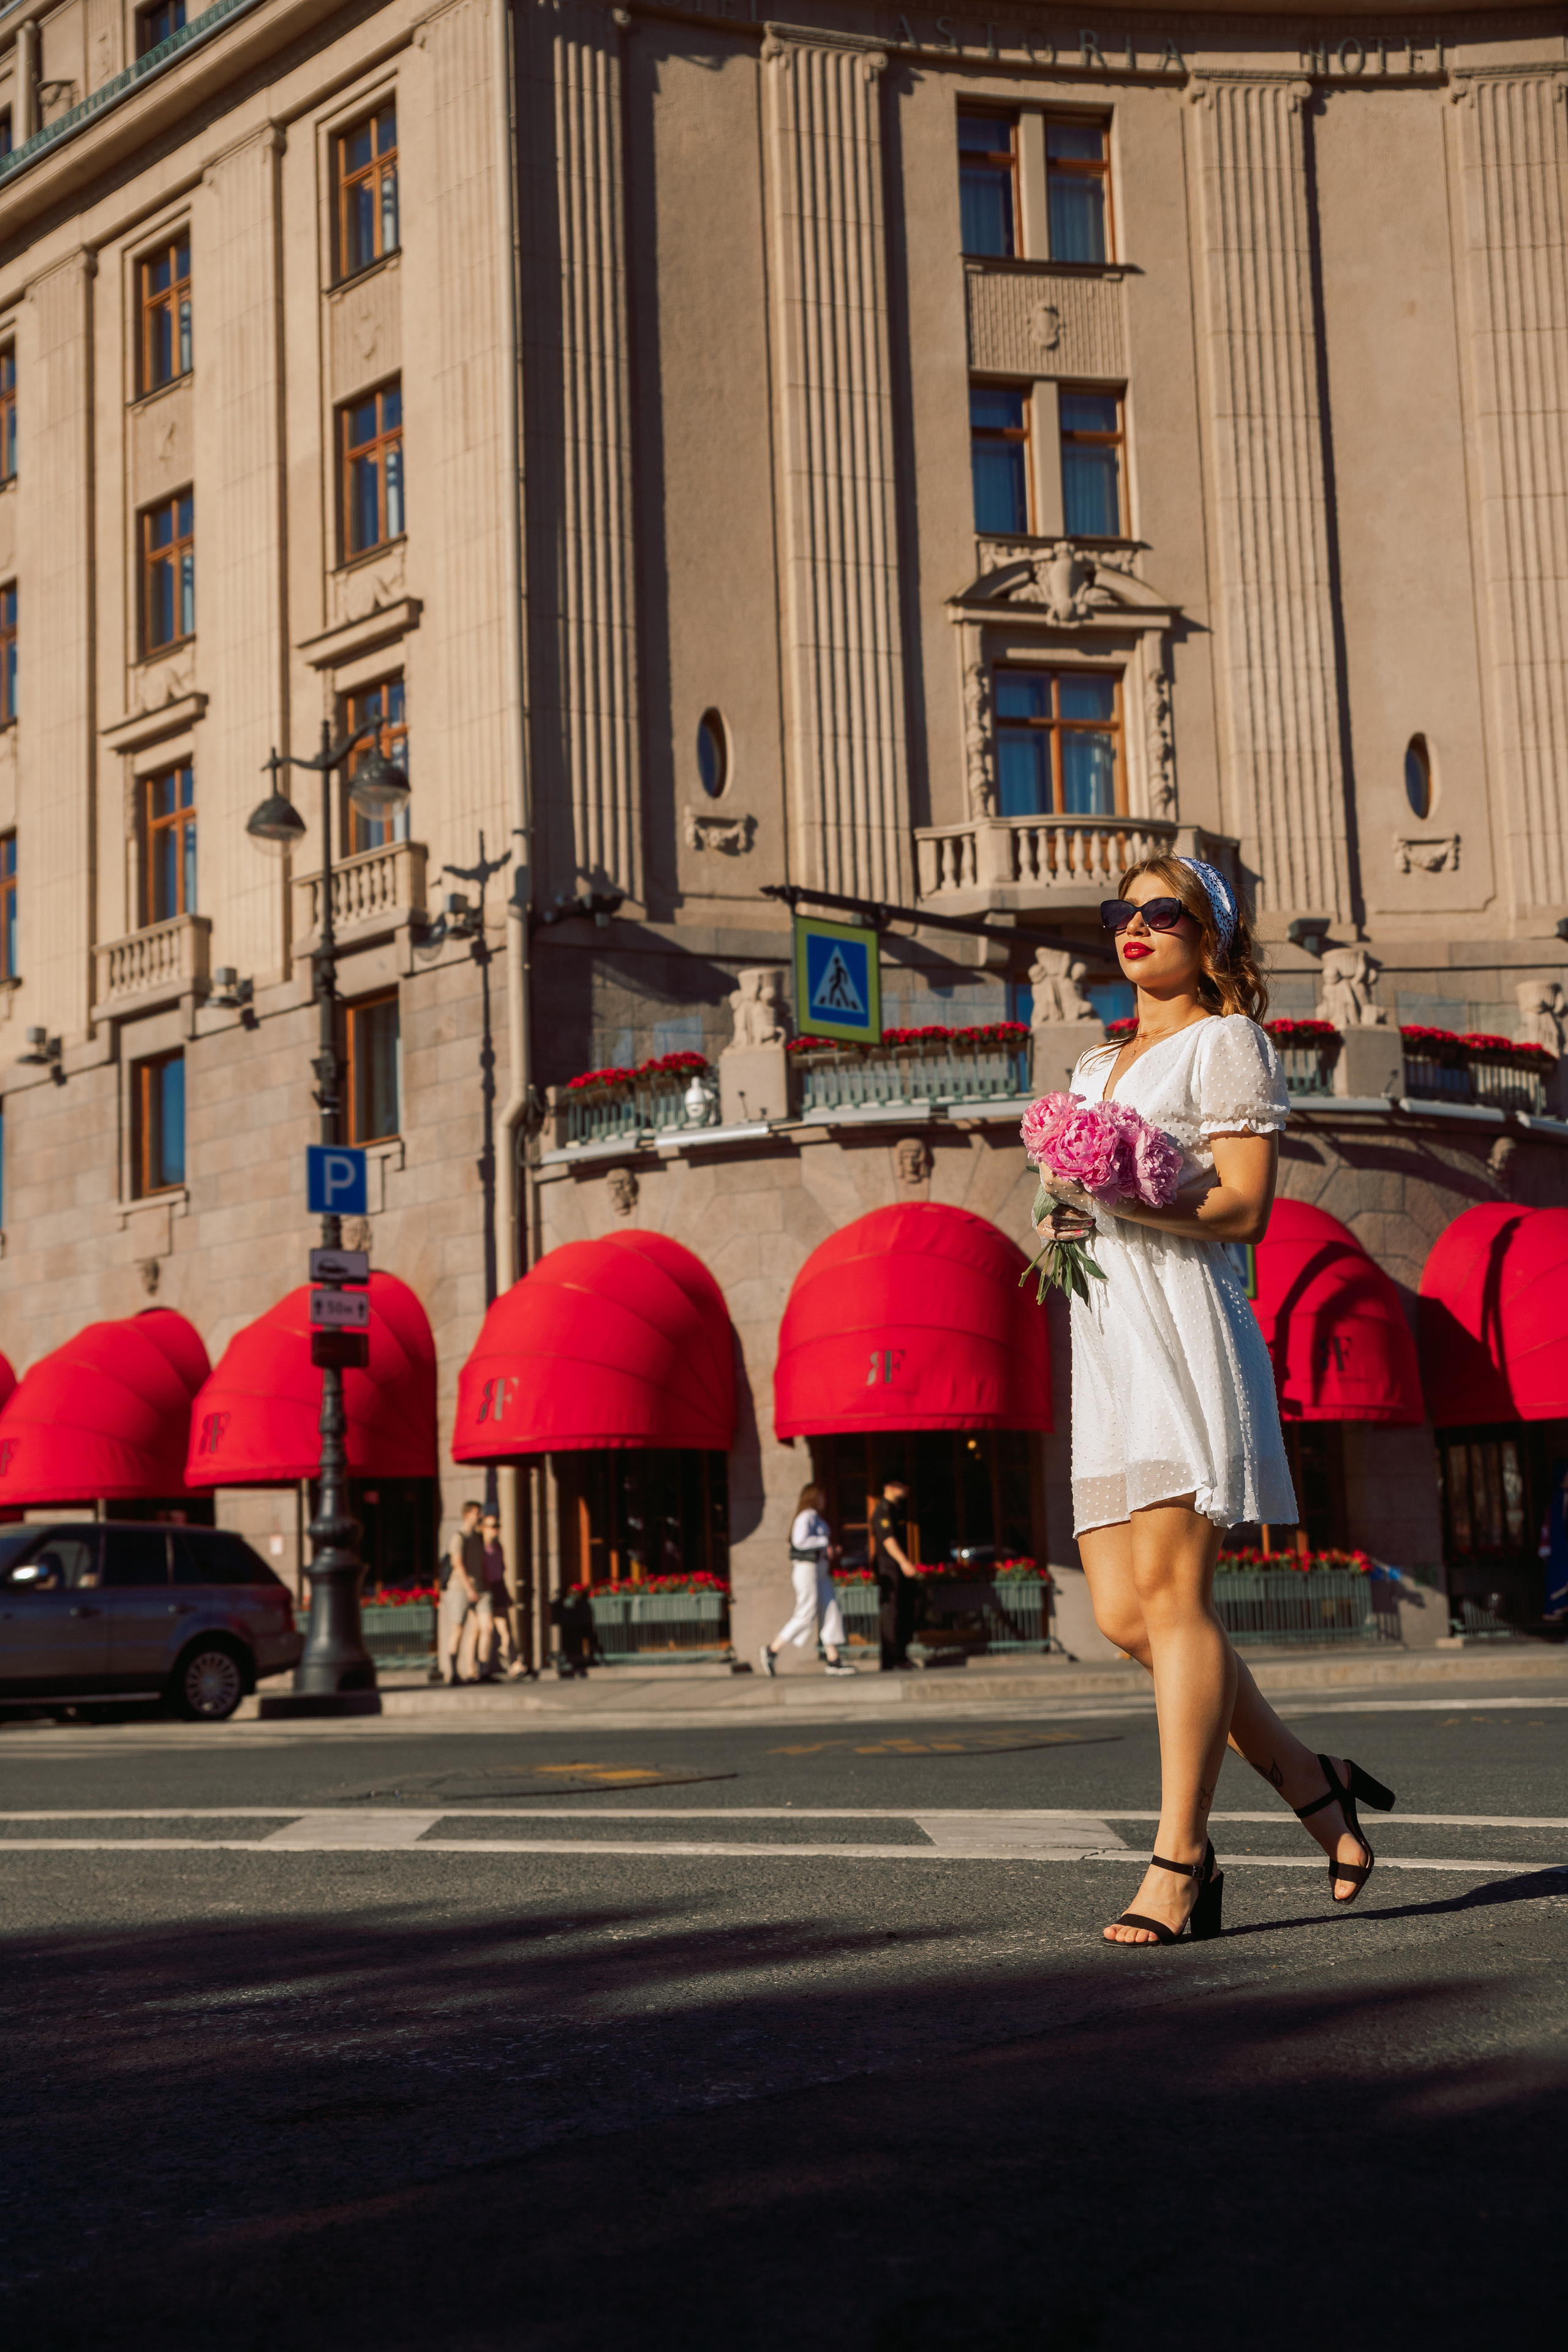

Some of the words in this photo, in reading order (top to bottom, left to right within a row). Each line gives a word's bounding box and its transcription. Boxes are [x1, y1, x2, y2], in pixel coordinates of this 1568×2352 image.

[891, 15, 1188, 72] ASTORIA
[1306, 36, 1447, 75] HOTEL
[323, 1155, 356, 1206] P
